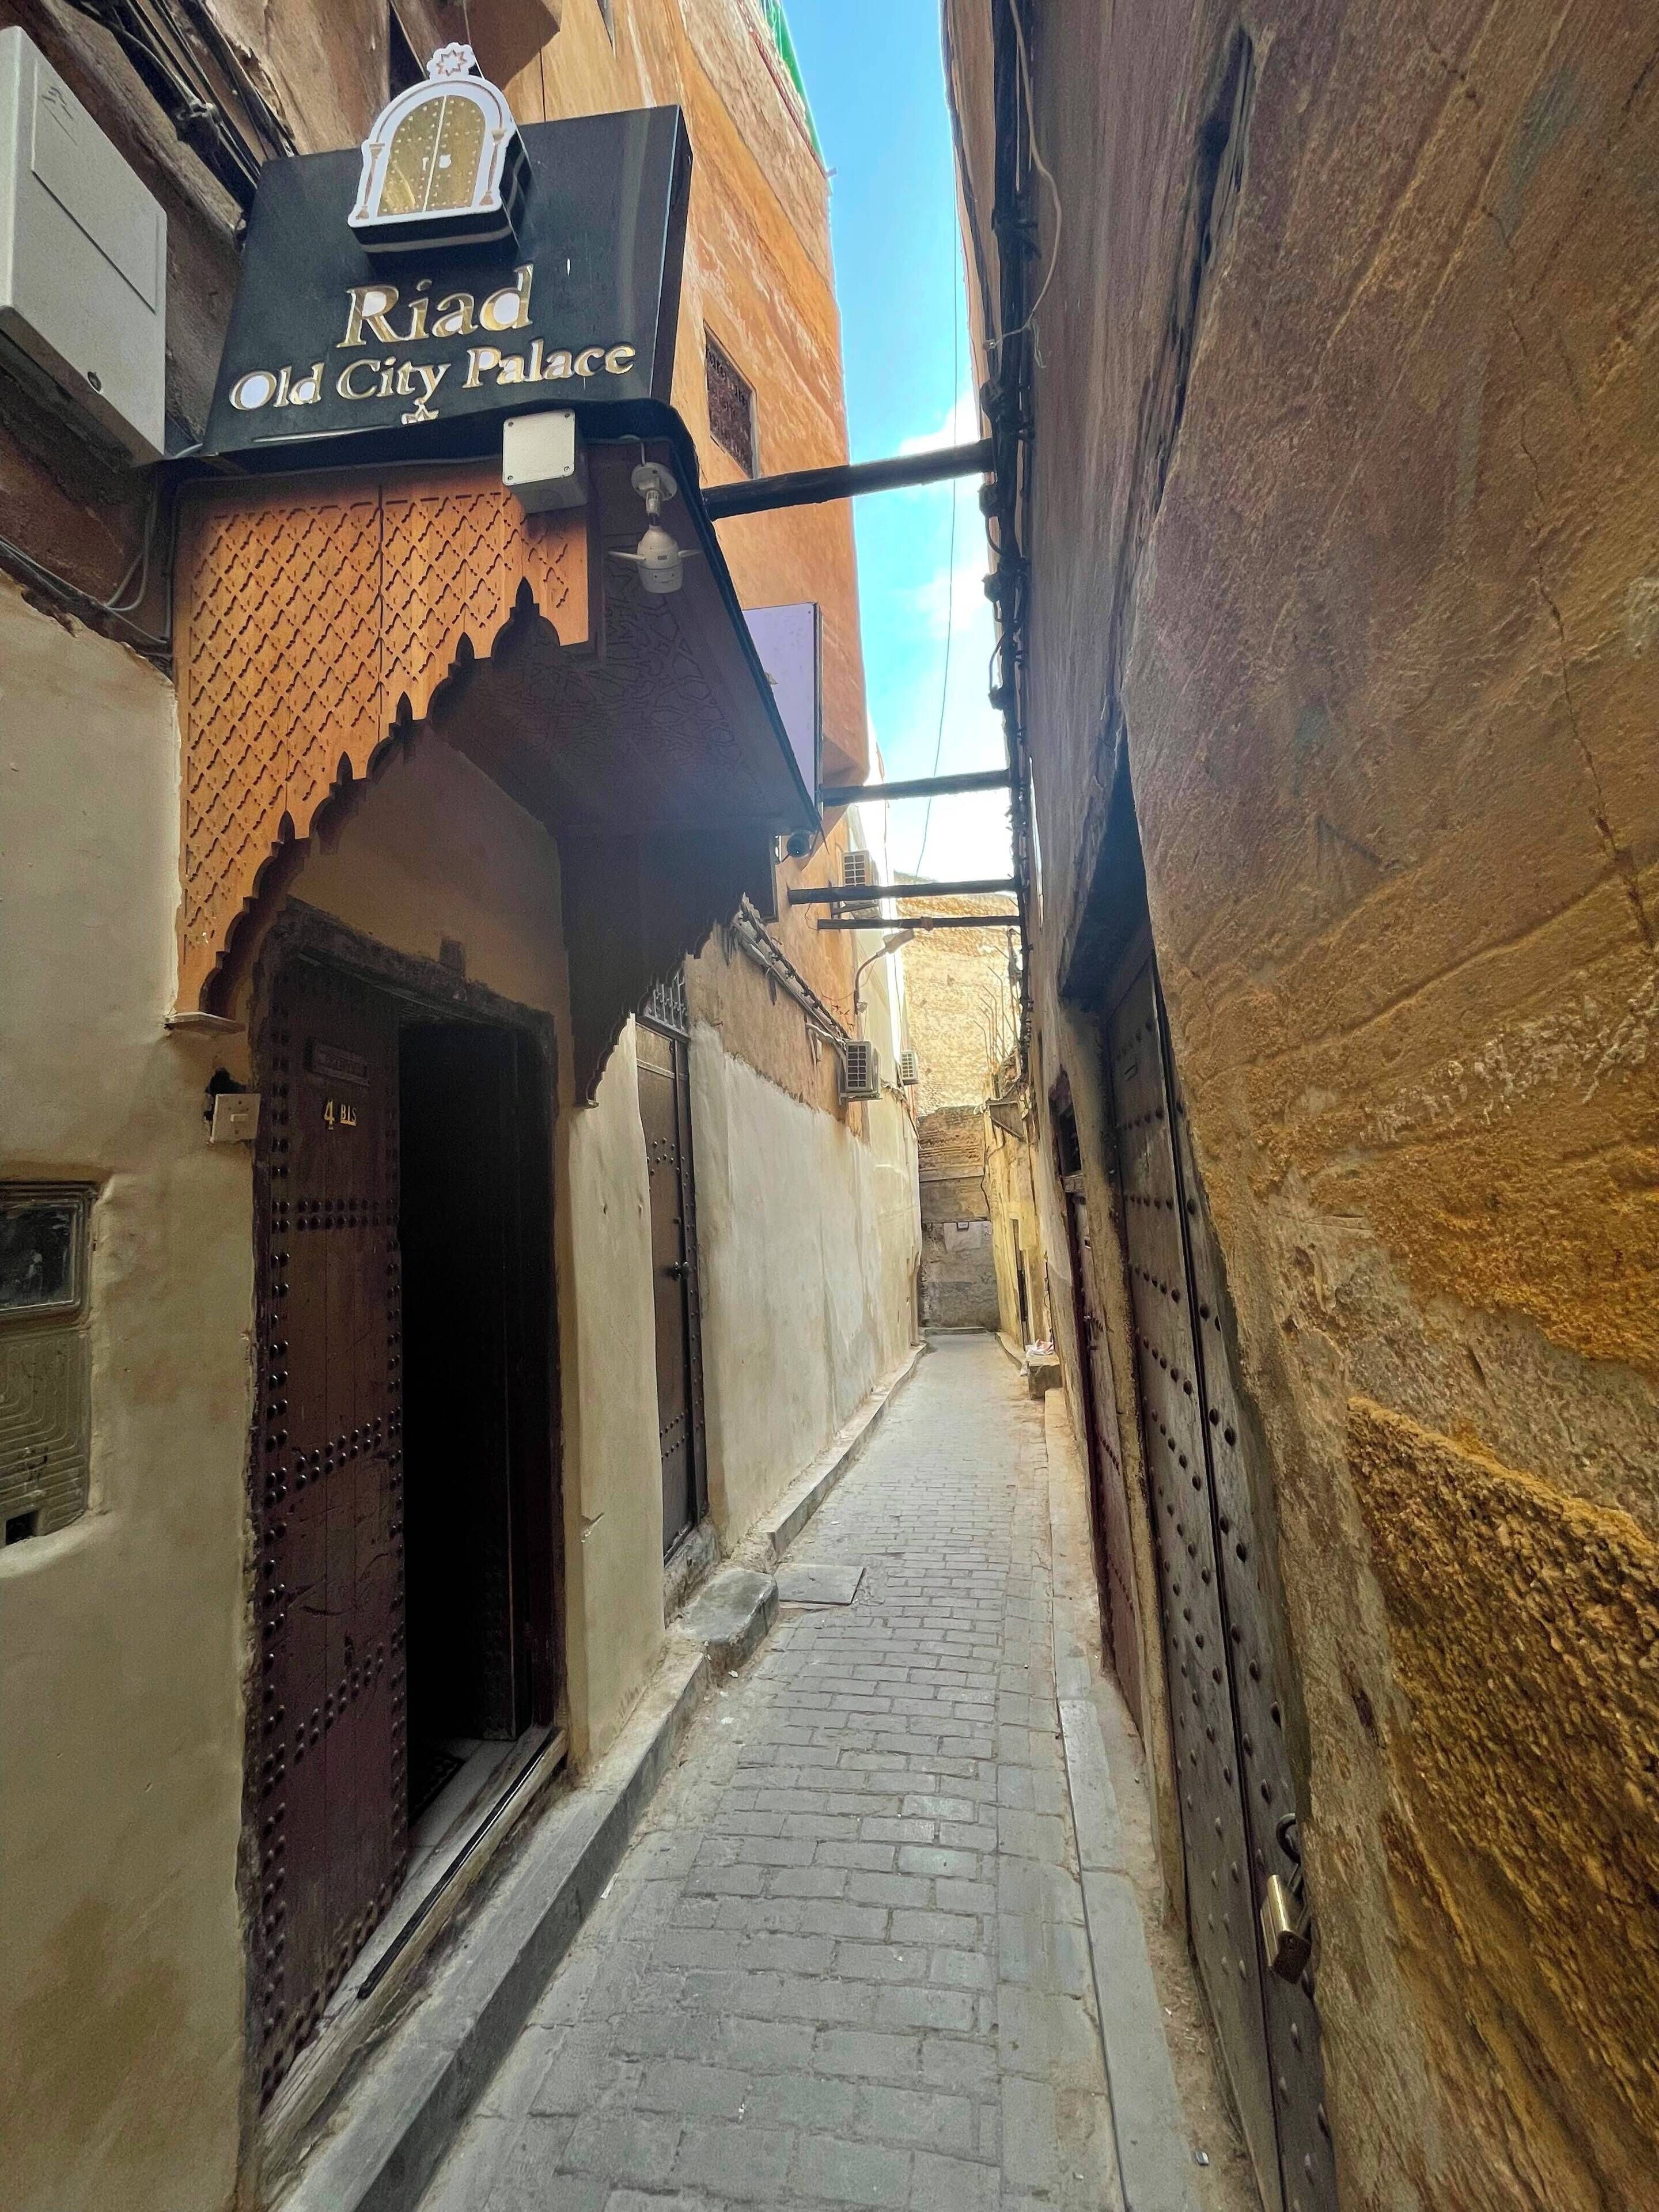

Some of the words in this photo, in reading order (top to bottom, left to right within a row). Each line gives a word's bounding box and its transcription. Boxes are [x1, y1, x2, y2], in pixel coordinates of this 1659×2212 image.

[336, 264, 534, 348] Riad
[230, 362, 324, 410] Old
[336, 356, 452, 406] City
[462, 339, 636, 388] Palace
[324, 1099, 335, 1130] 4
[340, 1104, 357, 1126] BIS
